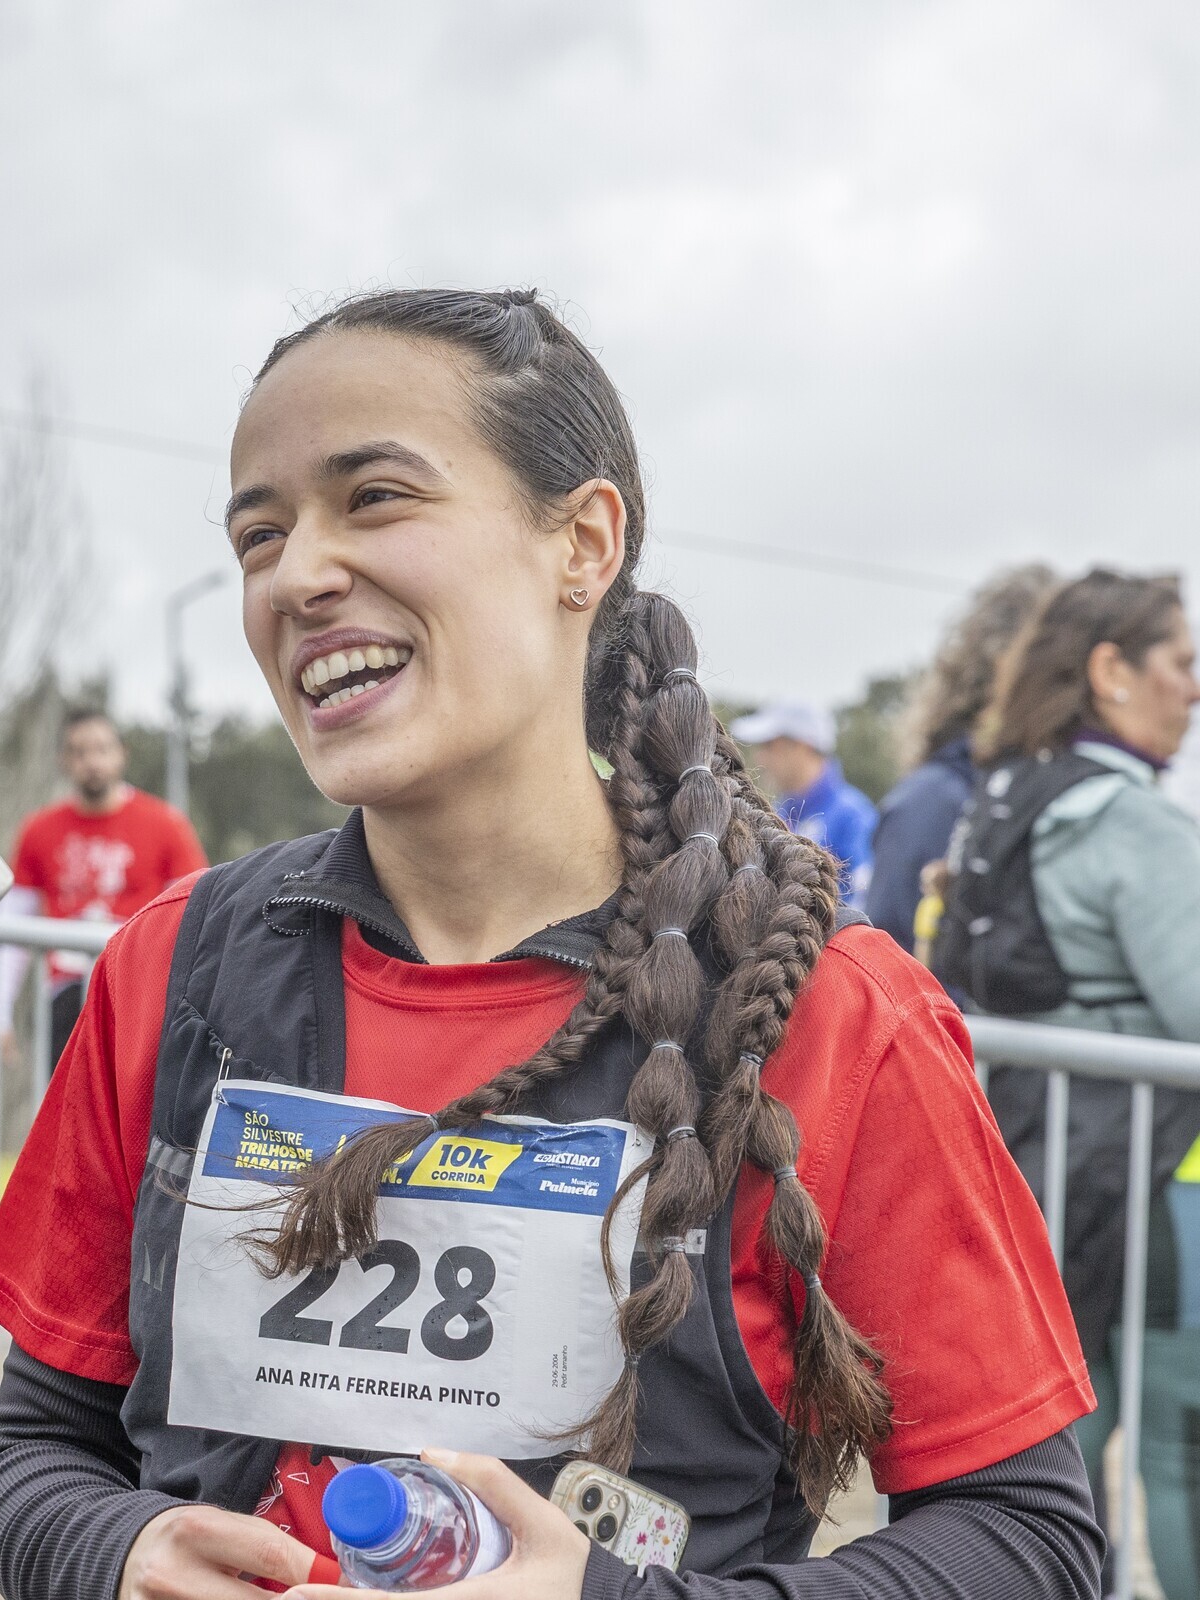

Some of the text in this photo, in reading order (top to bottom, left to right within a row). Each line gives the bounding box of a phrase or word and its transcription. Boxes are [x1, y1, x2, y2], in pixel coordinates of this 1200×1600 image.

[244, 1110, 269, 1127] SÃO
[243, 1126, 304, 1146] SILVESTRE
[240, 1141, 314, 1162] TRILHOS DE
[431, 1170, 486, 1185] CORRIDA
[539, 1180, 599, 1197] Palmela
[258, 1239, 497, 1361] 228
[255, 1366, 501, 1408] ANA RITA FERREIRA PINTO
